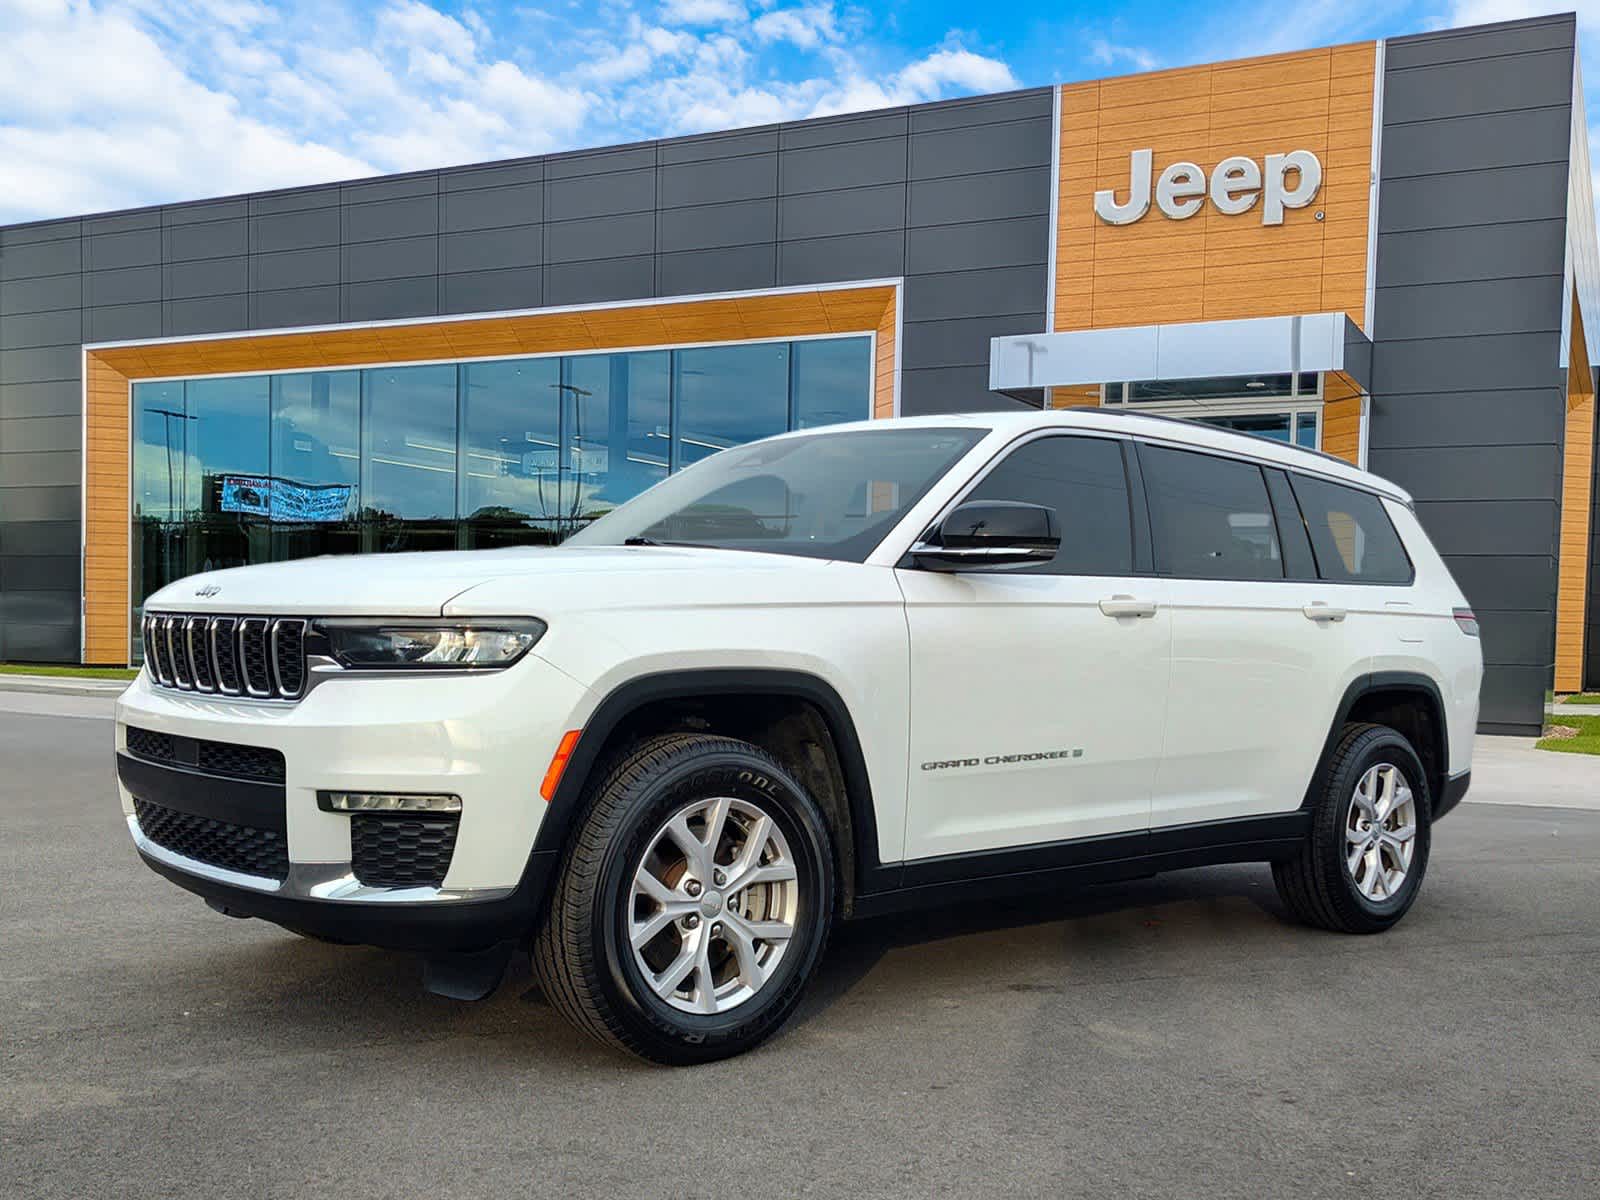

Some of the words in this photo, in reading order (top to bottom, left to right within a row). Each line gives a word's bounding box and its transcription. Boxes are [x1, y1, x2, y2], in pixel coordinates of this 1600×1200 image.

[1094, 148, 1322, 226] Jeep
[920, 757, 980, 771] GRAND
[983, 750, 1069, 765] CHEROKEE
